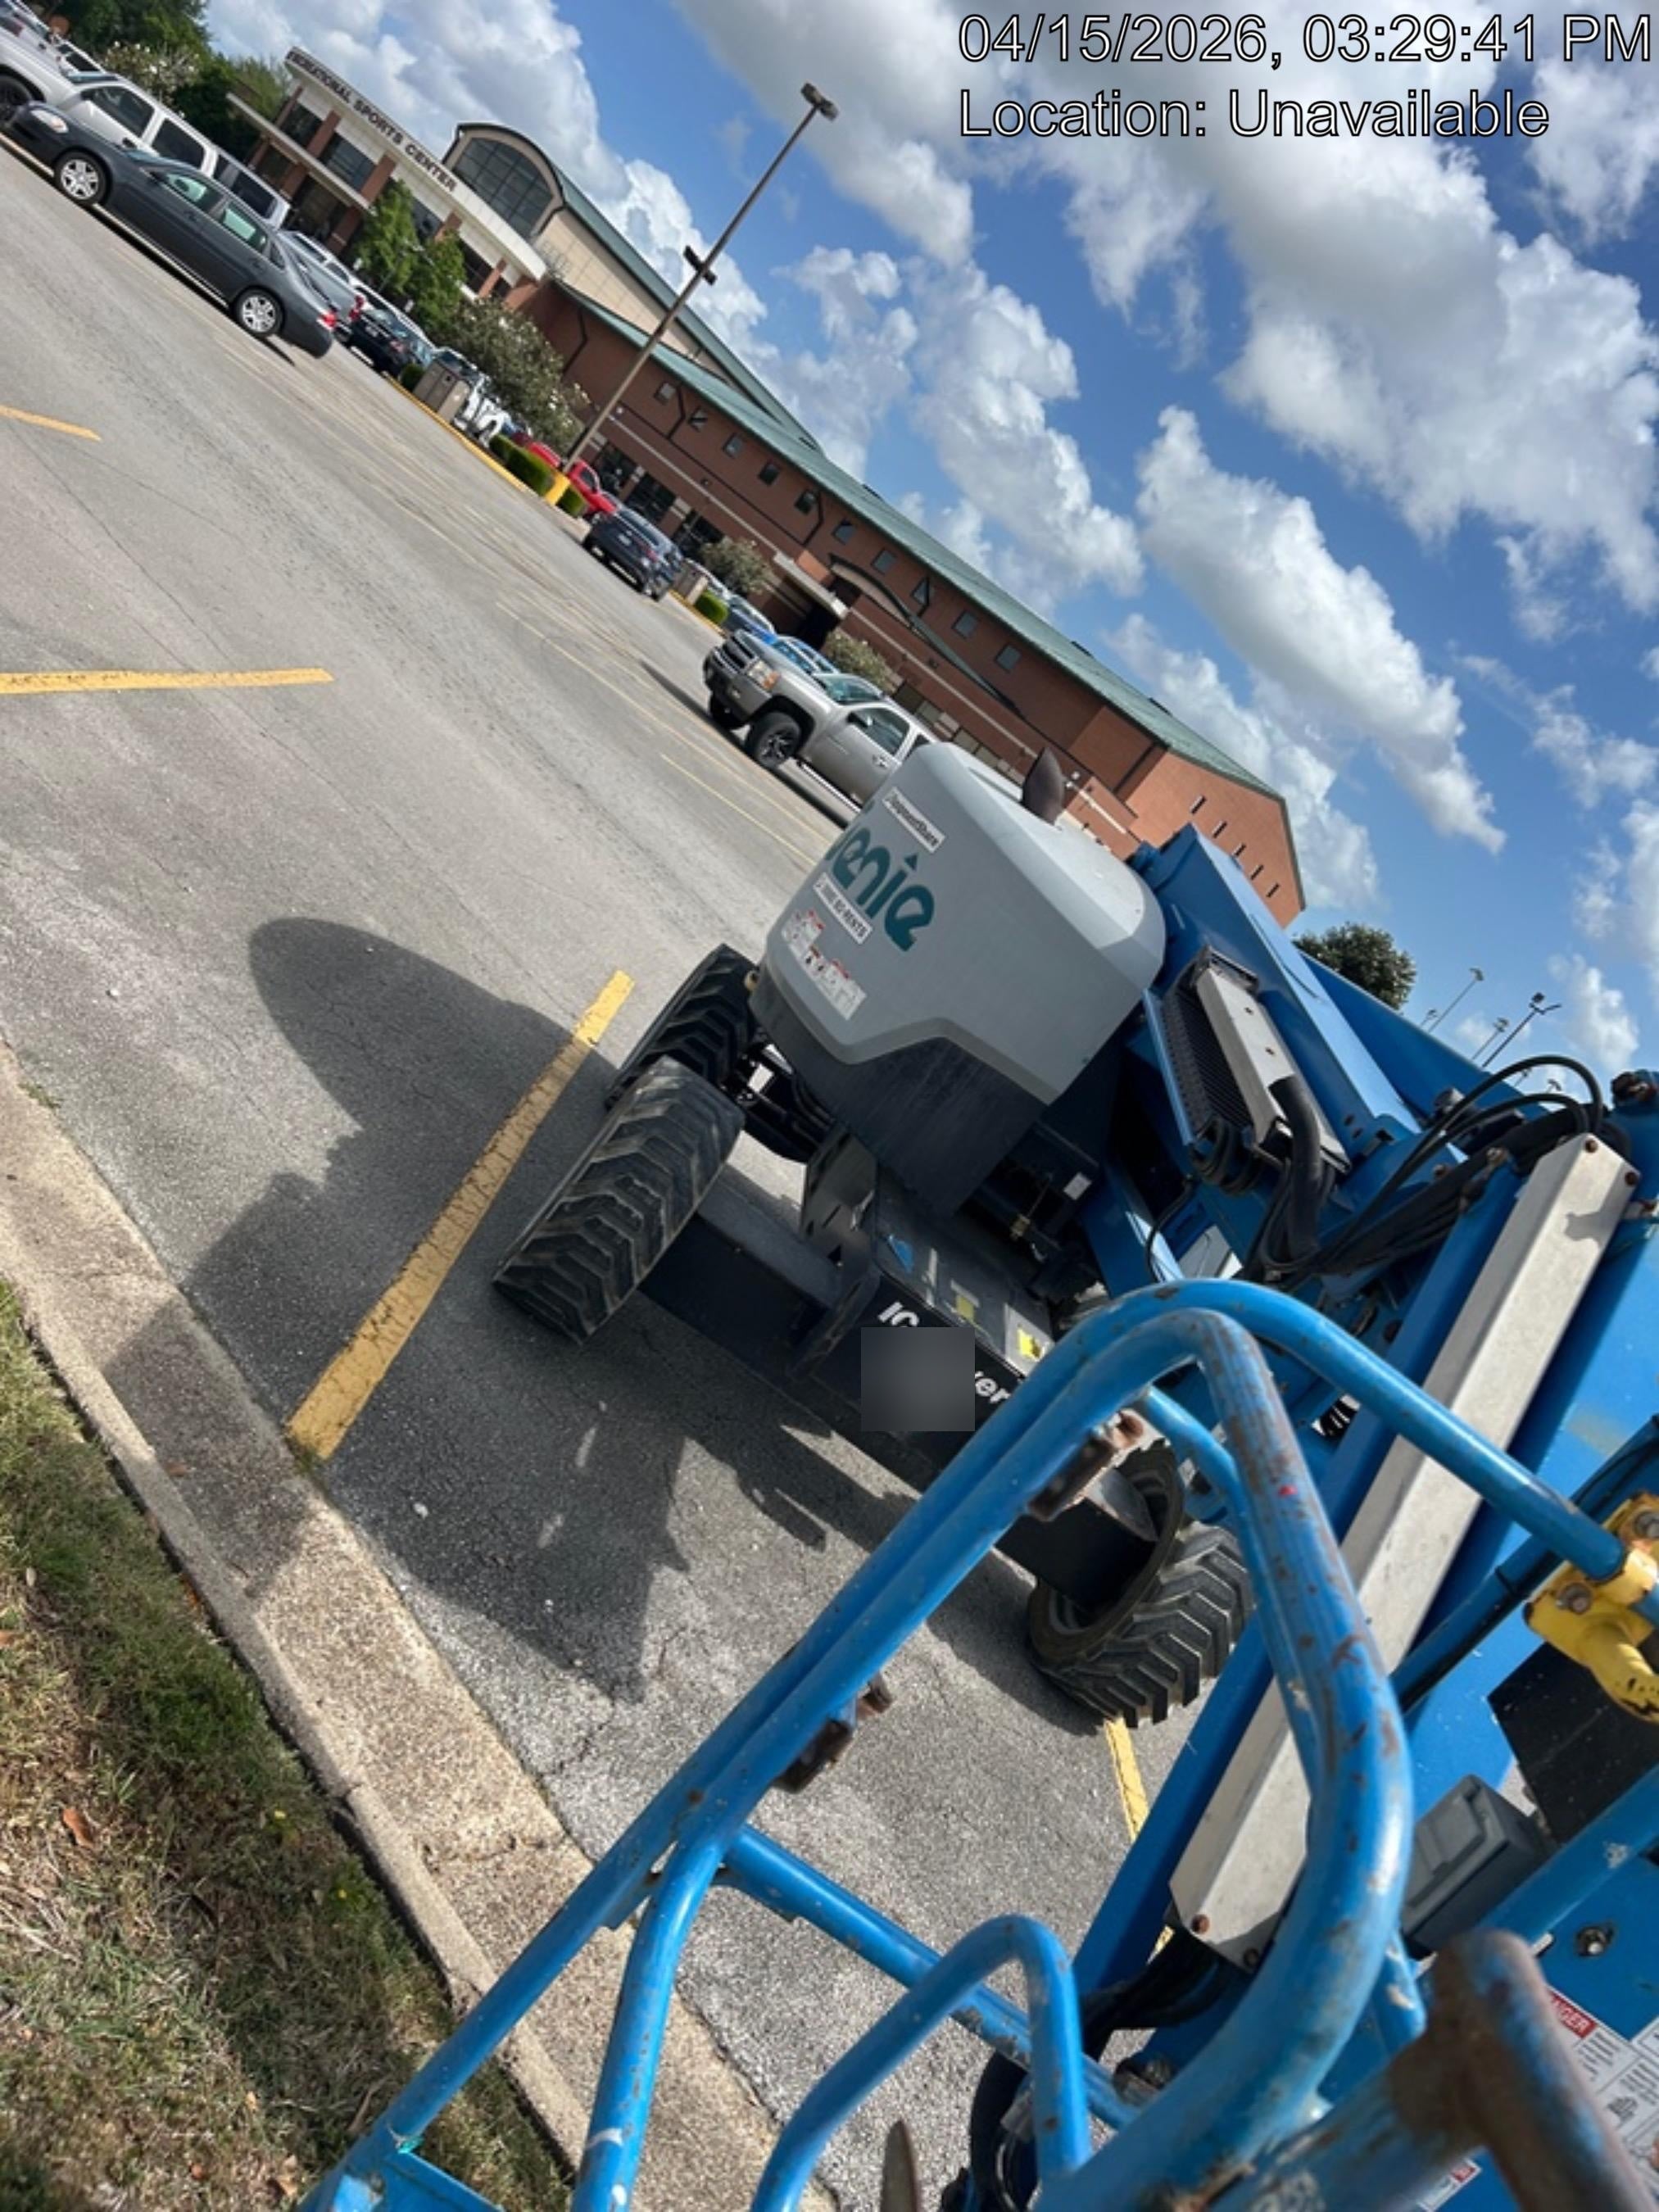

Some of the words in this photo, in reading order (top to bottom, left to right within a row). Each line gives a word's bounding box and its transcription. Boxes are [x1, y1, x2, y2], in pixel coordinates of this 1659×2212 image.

[353, 99, 403, 144] SPORTS
[405, 144, 457, 192] CENTER
[823, 826, 935, 952] enie
